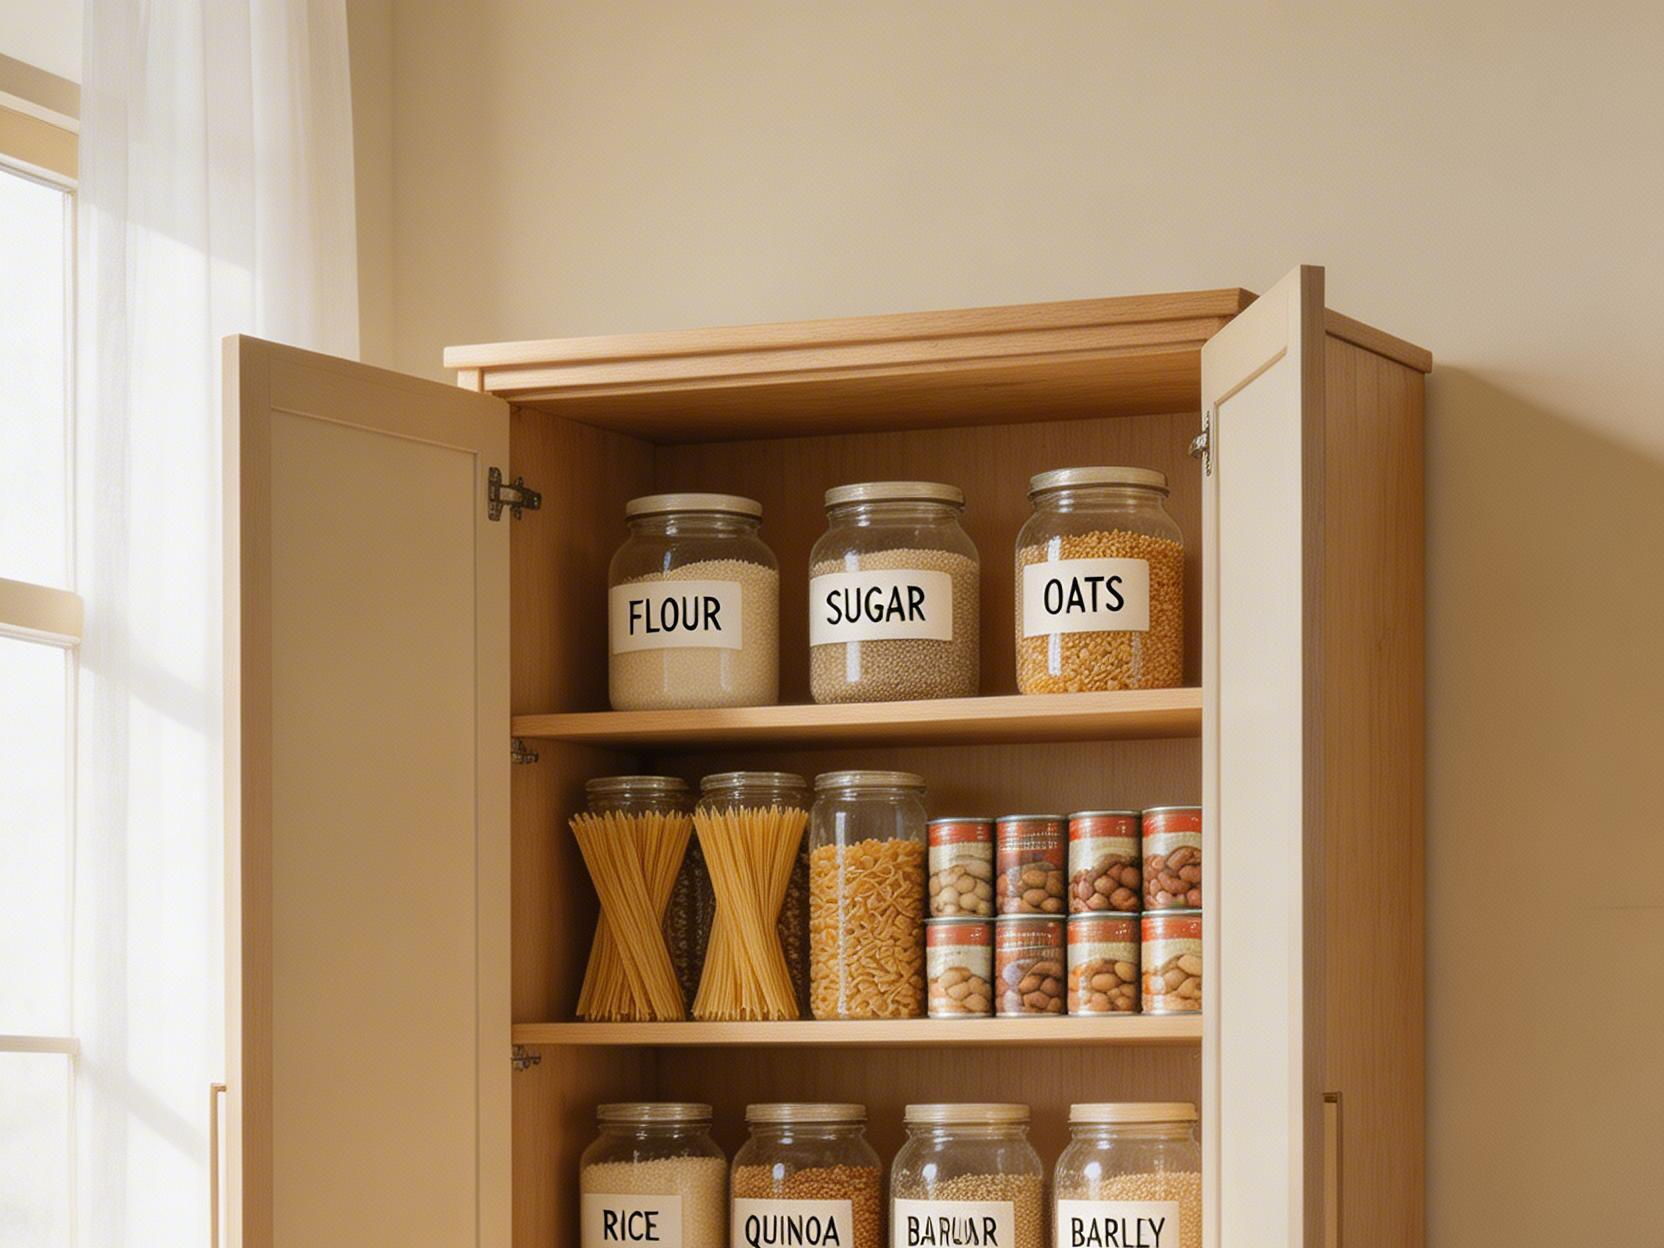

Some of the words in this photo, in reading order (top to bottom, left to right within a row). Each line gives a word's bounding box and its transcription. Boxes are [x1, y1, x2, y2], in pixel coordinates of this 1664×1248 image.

[826, 585, 927, 626] SUGAR
[1043, 575, 1125, 616] OATS
[628, 595, 722, 635] FLOUR
[602, 1208, 660, 1242] RICE
[744, 1214, 841, 1248] QUINOA
[1071, 1216, 1166, 1248] BARLEY
